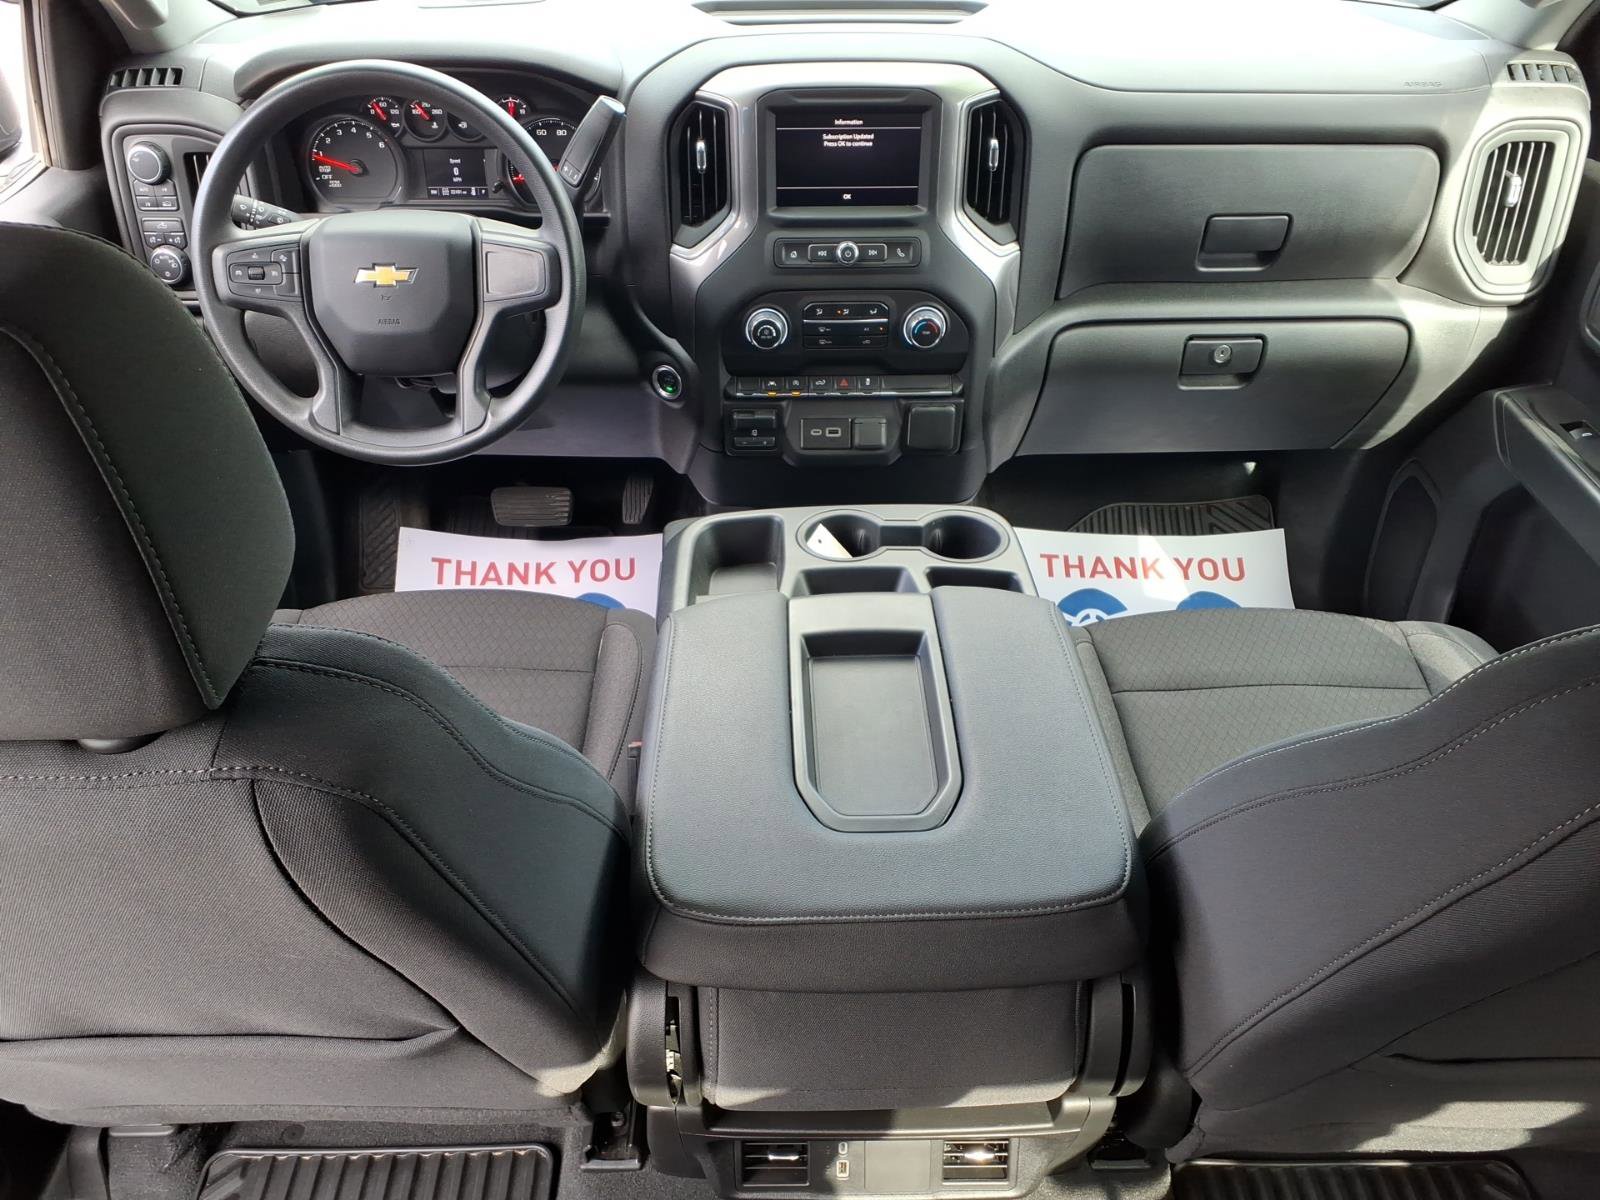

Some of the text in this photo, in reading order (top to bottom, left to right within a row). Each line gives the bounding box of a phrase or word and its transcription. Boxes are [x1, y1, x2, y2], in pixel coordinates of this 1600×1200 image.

[431, 556, 636, 586] THANK YOU
[1040, 553, 1246, 582] THANK YOU
